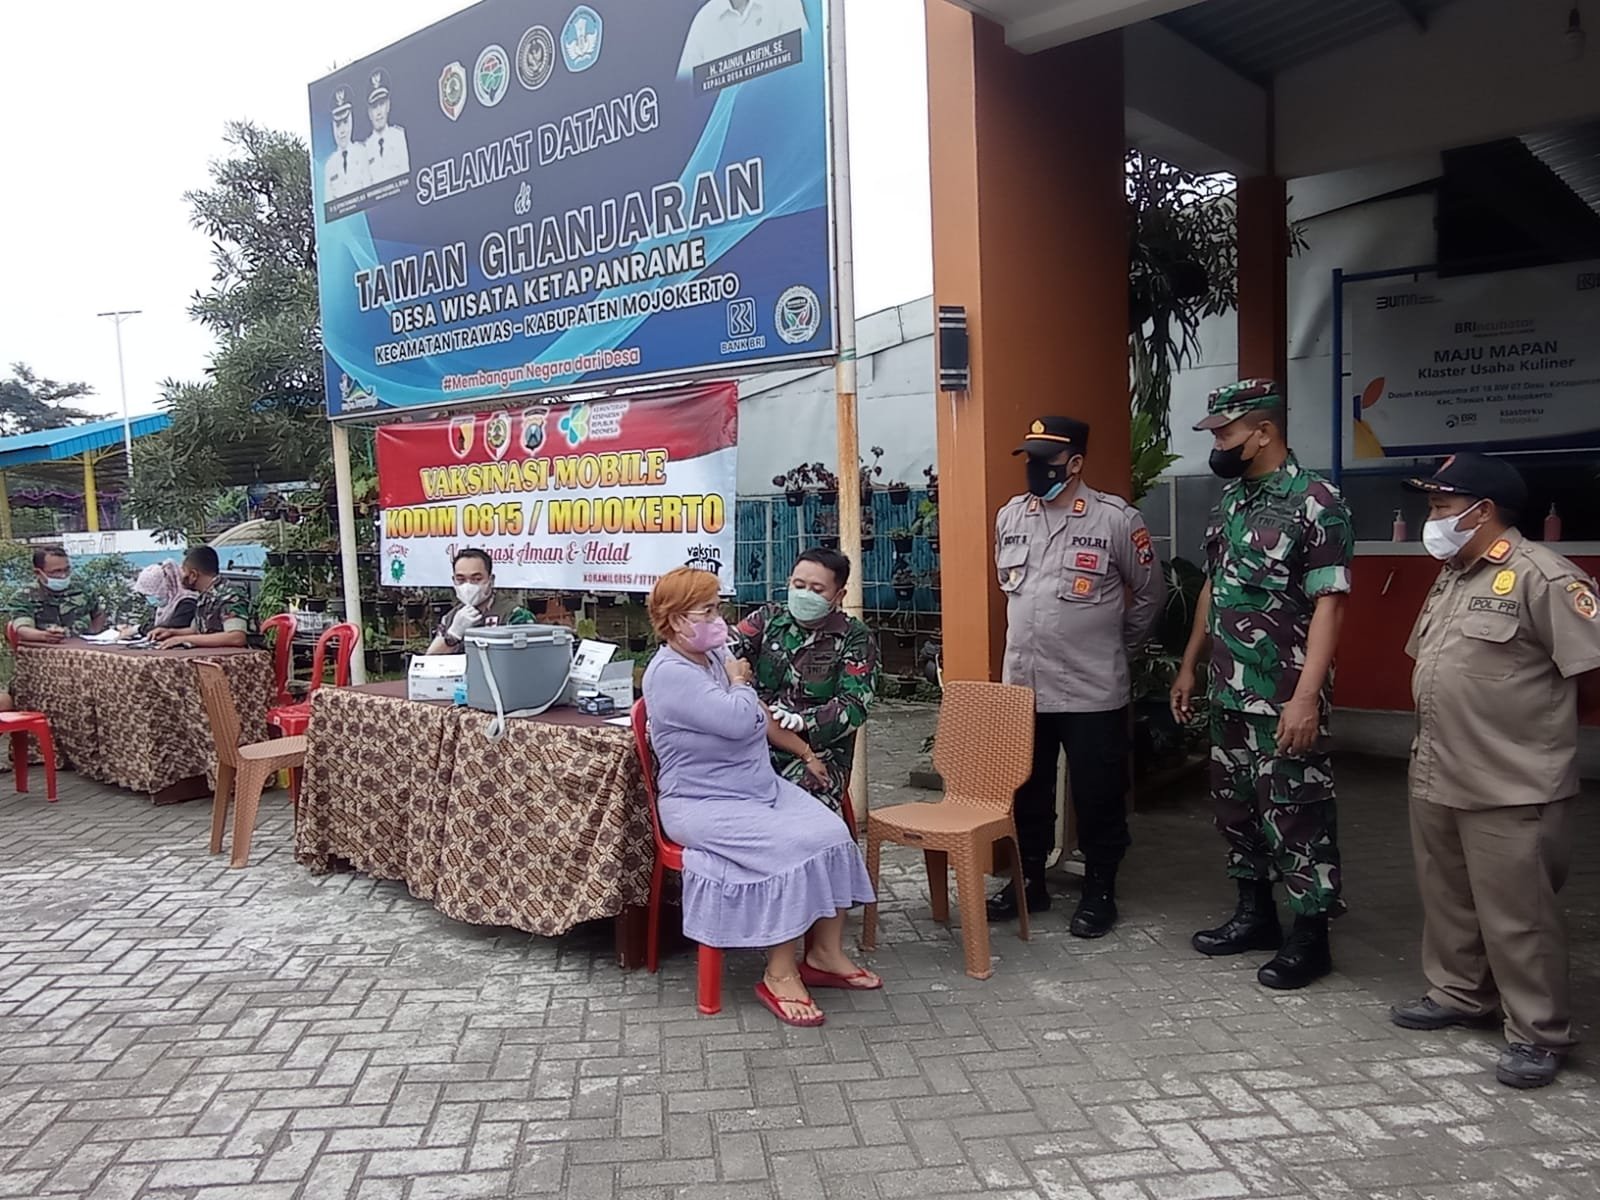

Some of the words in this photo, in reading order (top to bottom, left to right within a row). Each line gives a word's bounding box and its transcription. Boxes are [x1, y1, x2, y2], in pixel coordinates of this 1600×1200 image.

[702, 77, 726, 91] KEPALA
[727, 70, 743, 83] DESA
[744, 52, 792, 76] KETAPANRAME
[709, 64, 717, 76] H.
[718, 53, 745, 73] ZAINUL
[773, 40, 784, 53] SE
[417, 131, 533, 205] SELAMAT
[538, 87, 659, 166] DATANG
[355, 242, 467, 312] TAMAN
[480, 157, 764, 280] GHANJARAN
[392, 302, 437, 333] DESA
[441, 285, 518, 322] WISATA
[524, 239, 705, 304] KETAPANRAME
[375, 332, 451, 365] KECAMATAN
[452, 322, 513, 351] TRAWAS
[524, 298, 618, 338] KABUPATEN
[622, 273, 739, 320] MOJOKERTO
[720, 338, 748, 354] BANK
[749, 335, 766, 348] BRI
[1433, 346, 1483, 363] MAJU
[1489, 340, 1558, 359] MAPAN
[442, 367, 524, 392] #Membangun
[526, 358, 572, 380] Negara
[574, 352, 602, 371] dari
[603, 348, 640, 369] Desa
[1418, 365, 1466, 379] Klaster
[1471, 359, 1515, 375] Usaha
[1520, 355, 1576, 371] Kuliner
[420, 458, 550, 500] VAKSINASI
[554, 449, 668, 490] MOBILE
[386, 505, 457, 539] KODIM
[463, 502, 523, 537] 0815
[528, 500, 544, 536] /
[548, 493, 725, 535] MOJOKERTO
[446, 543, 514, 563] Vnasi
[517, 542, 563, 566] Aman
[566, 541, 580, 564] &
[583, 541, 631, 564] Halal
[687, 543, 720, 560] vaksin
[1072, 536, 1107, 549] POLRI
[1472, 599, 1493, 609] POL
[1498, 601, 1516, 612] PP
